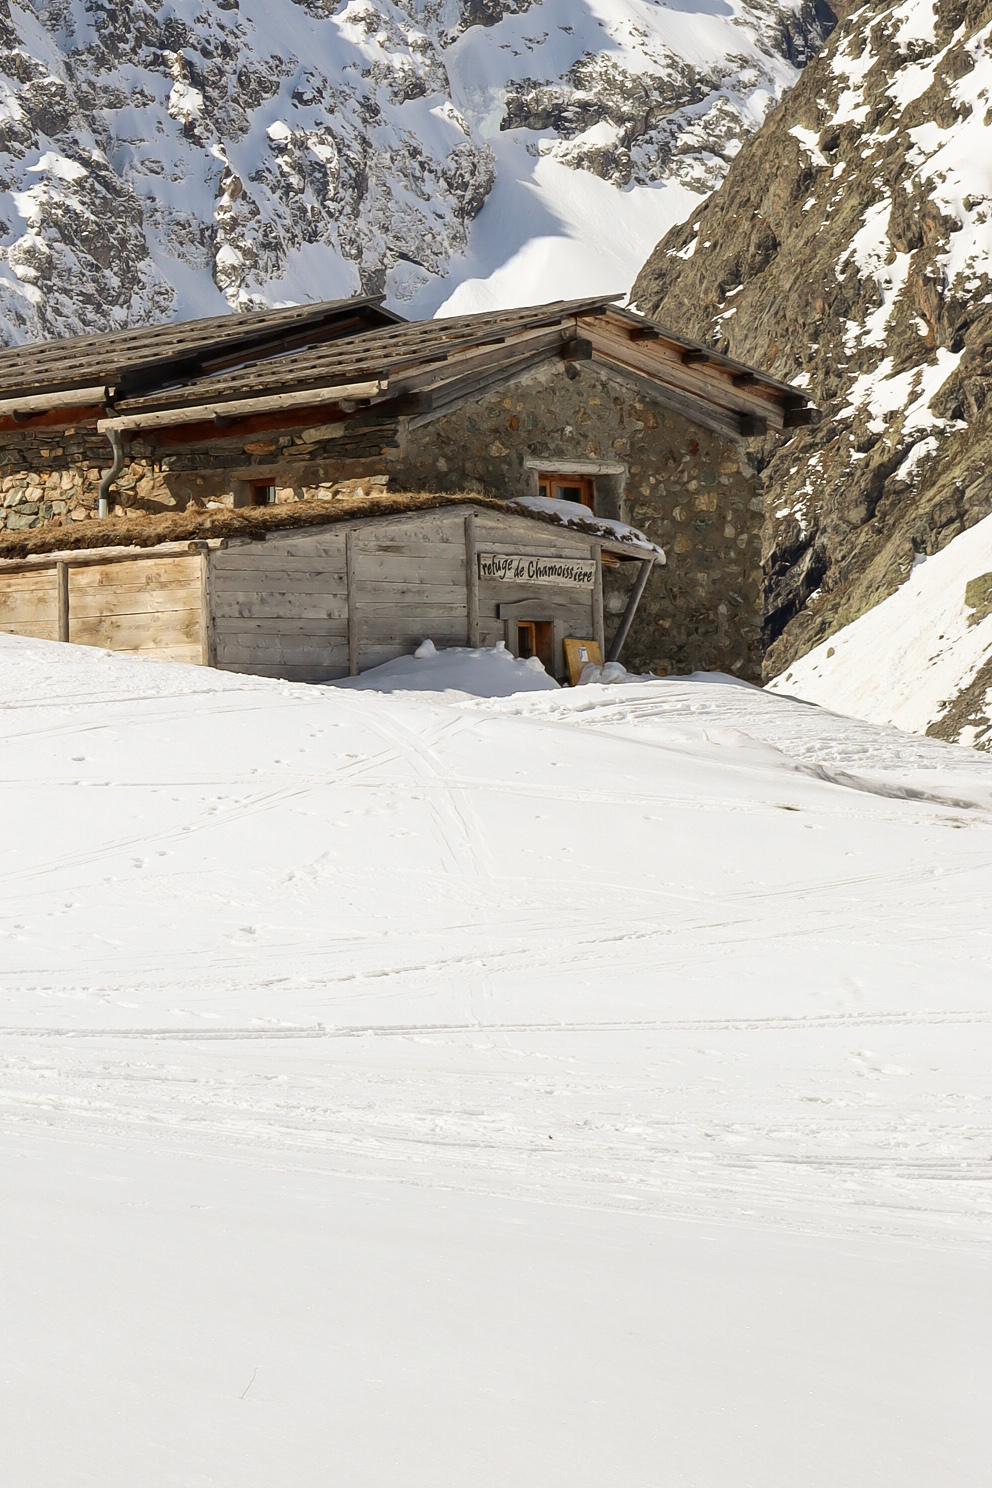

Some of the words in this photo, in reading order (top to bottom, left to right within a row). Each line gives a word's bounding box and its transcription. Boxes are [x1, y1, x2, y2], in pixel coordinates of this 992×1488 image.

[482, 555, 513, 579] refuge
[514, 558, 525, 578] de
[527, 558, 593, 583] Chamoissière
